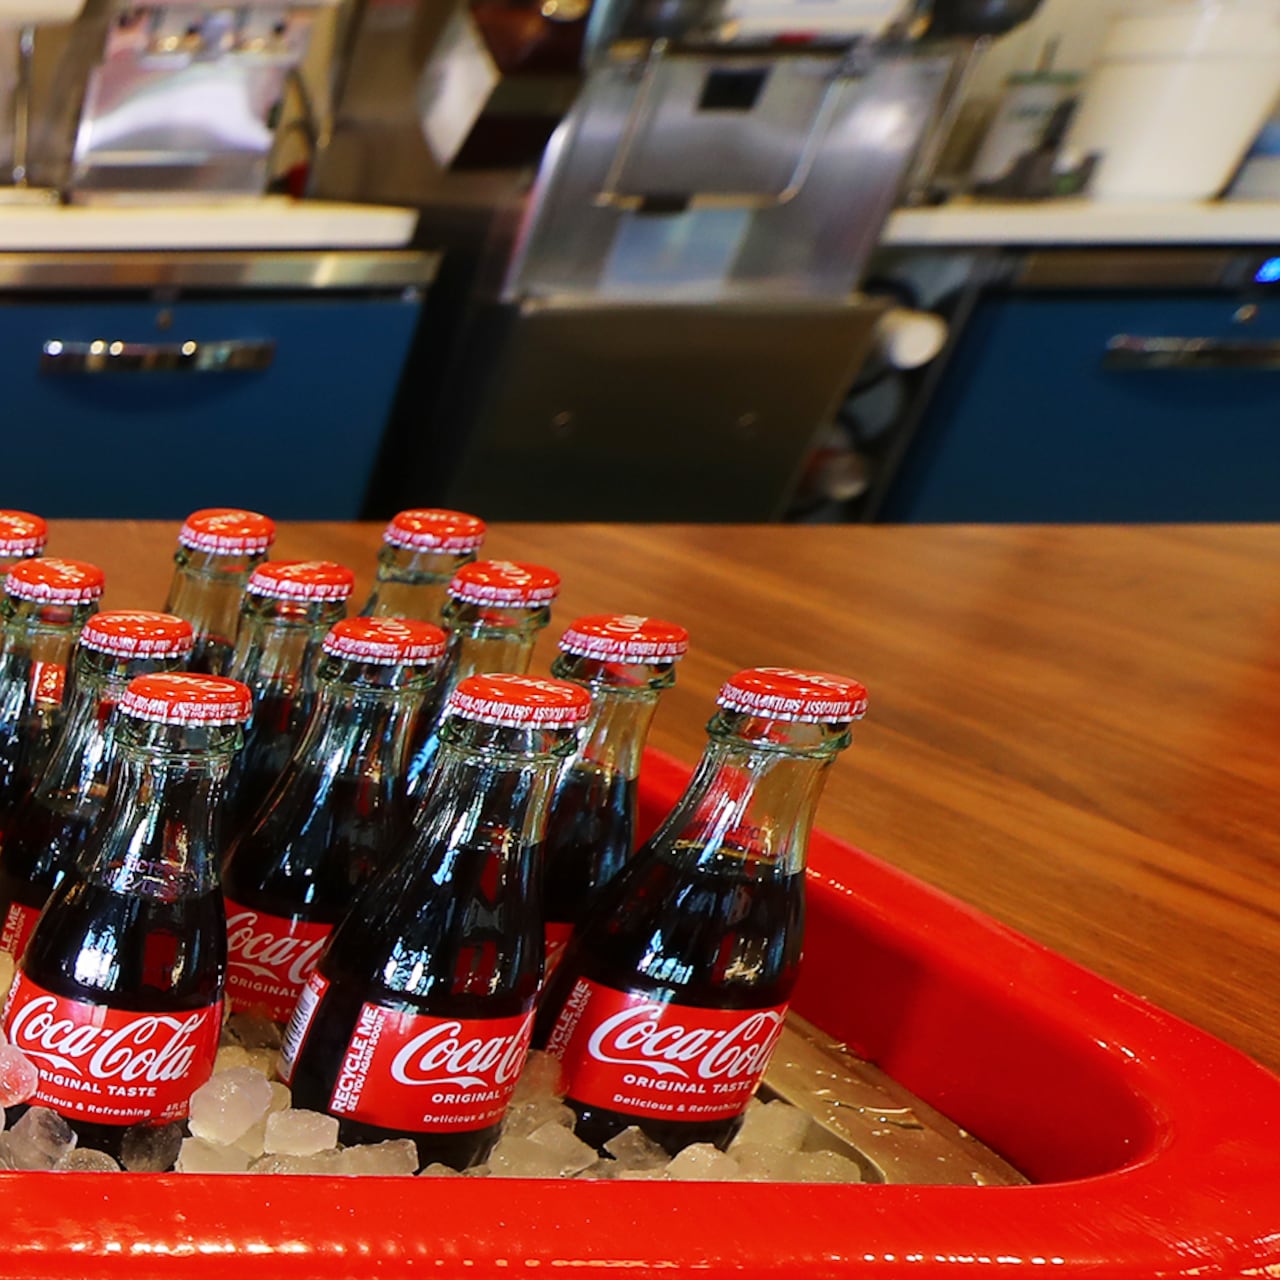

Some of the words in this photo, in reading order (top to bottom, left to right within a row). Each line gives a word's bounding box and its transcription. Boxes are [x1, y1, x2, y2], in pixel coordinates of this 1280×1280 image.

[230, 975, 298, 998] ORIGINAL
[569, 980, 589, 1007] ME
[10, 995, 207, 1082] Coca-Cola
[331, 1037, 367, 1113] RECYCLE
[357, 1006, 379, 1037] ME
[37, 1069, 101, 1094] RIGINAL
[107, 1084, 157, 1097] TASTE
[347, 1094, 359, 1112] SEE
[353, 1075, 365, 1093] YOU
[359, 1045, 374, 1075] AGAIN
[623, 1074, 706, 1094] ORIGINAL
[34, 1092, 75, 1109] licious
[76, 1103, 84, 1112] &
[88, 1105, 151, 1117] Refreshing
[431, 1091, 501, 1104] ORIGINAL
[613, 1094, 673, 1112] Delicious
[677, 1103, 685, 1112] &
[423, 1112, 476, 1123] Delicious
